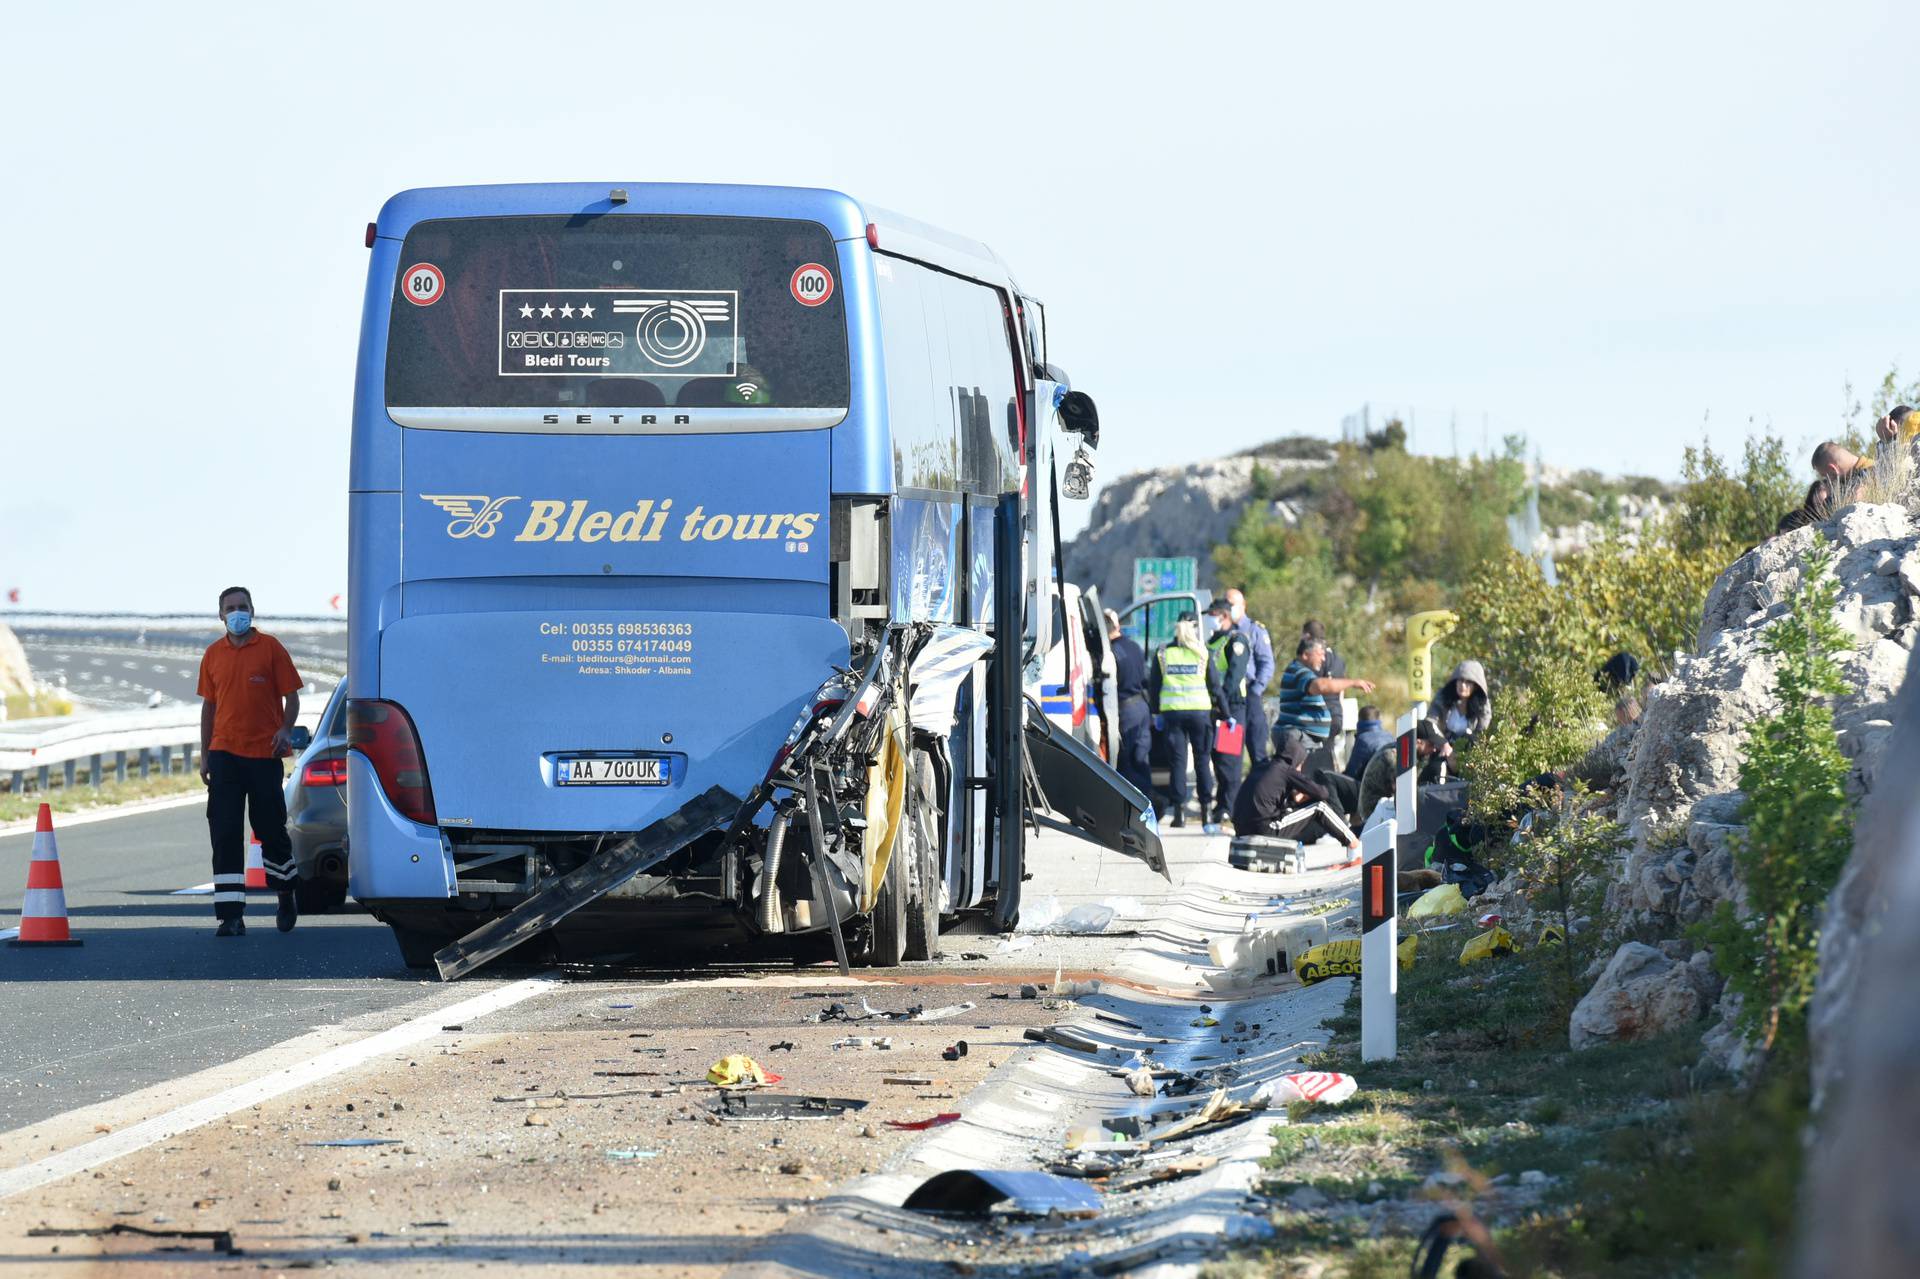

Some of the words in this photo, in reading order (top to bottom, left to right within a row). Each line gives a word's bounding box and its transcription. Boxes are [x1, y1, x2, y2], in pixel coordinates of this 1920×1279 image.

[413, 276, 434, 293] 80
[800, 276, 826, 293] 100
[592, 335, 606, 344] WC
[524, 354, 565, 367] Bledi
[567, 354, 611, 367] Tours
[543, 414, 691, 425] SETRA
[513, 498, 673, 543] Bledi
[680, 505, 821, 541] tours
[540, 622, 569, 635] Cel:
[572, 622, 614, 636] 00355
[617, 622, 693, 636] 698536363
[572, 639, 614, 652] 00355
[616, 639, 693, 652] 674174049
[541, 653, 575, 664] E-mail:
[577, 653, 692, 666] bleditours@hotmail.com
[578, 665, 613, 675] Adresa:
[614, 665, 651, 675] Shkoder
[658, 665, 692, 675] Albania
[573, 761, 593, 778] AA
